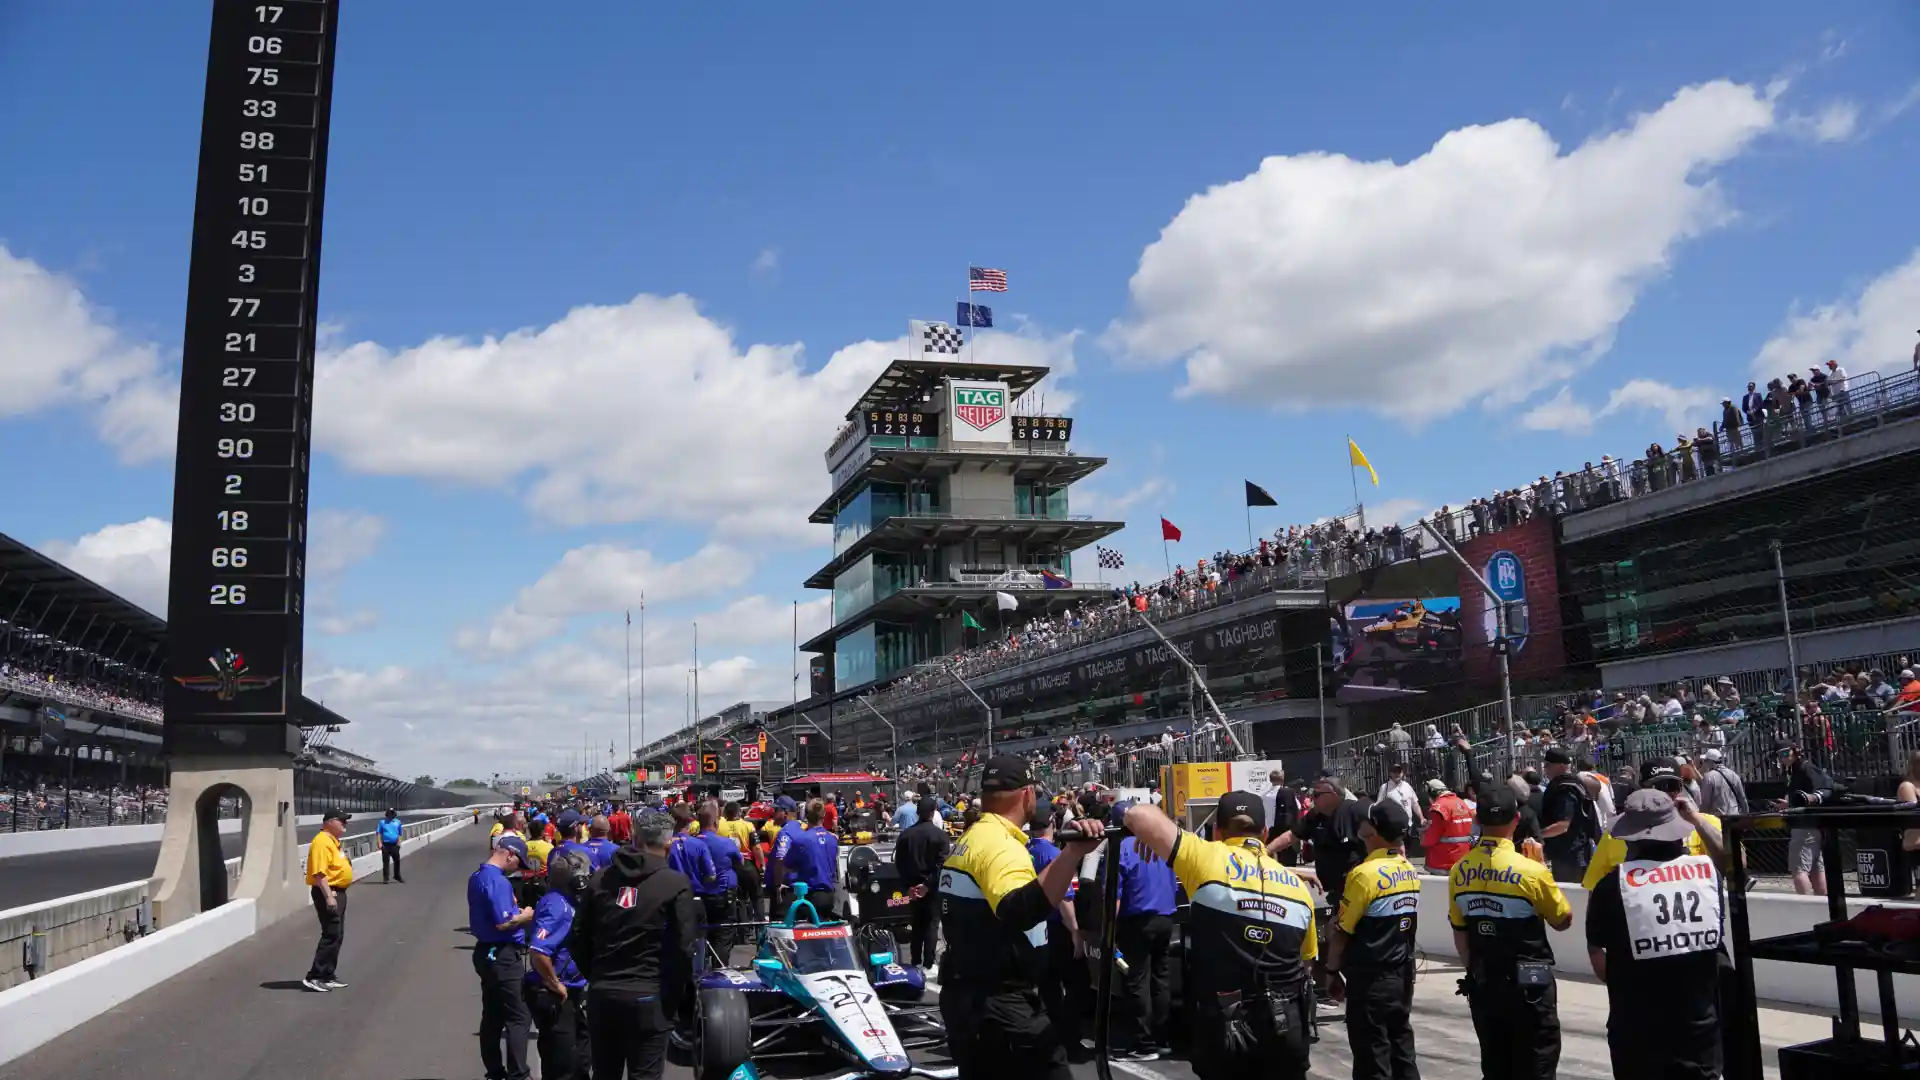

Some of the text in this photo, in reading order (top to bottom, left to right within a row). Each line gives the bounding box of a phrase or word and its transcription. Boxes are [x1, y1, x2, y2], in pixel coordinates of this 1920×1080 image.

[256, 6, 283, 23] 17
[249, 36, 282, 54] 06
[247, 68, 278, 86] 75
[243, 100, 277, 117] 33
[240, 132, 274, 150] 98
[239, 164, 268, 182] 51
[238, 197, 268, 215] 10
[232, 231, 266, 249] 45
[238, 264, 255, 282] 3
[228, 298, 260, 317] 77
[225, 333, 256, 352] 21
[222, 368, 256, 386] 27
[960, 391, 999, 404] TAG
[220, 403, 255, 422] 30
[871, 413, 878, 421] 5
[959, 407, 1001, 426] HEUER
[872, 424, 920, 434] 1 2 3 4
[1019, 429, 1066, 440] 5 6 7 8
[217, 439, 253, 458] 90
[225, 475, 242, 494] 2
[217, 511, 248, 530] 18
[212, 548, 247, 567] 66
[210, 585, 246, 604] 26
[741, 747, 759, 759] 28
[703, 754, 717, 772] 5
[1226, 852, 1300, 888] Splenda
[1454, 859, 1522, 887] Splenda
[1625, 863, 1712, 887] Canon
[1240, 900, 1259, 909] JAVA
[1653, 890, 1703, 925] 342
[1634, 929, 1719, 954] PHOTO
[829, 992, 873, 1009] 27
